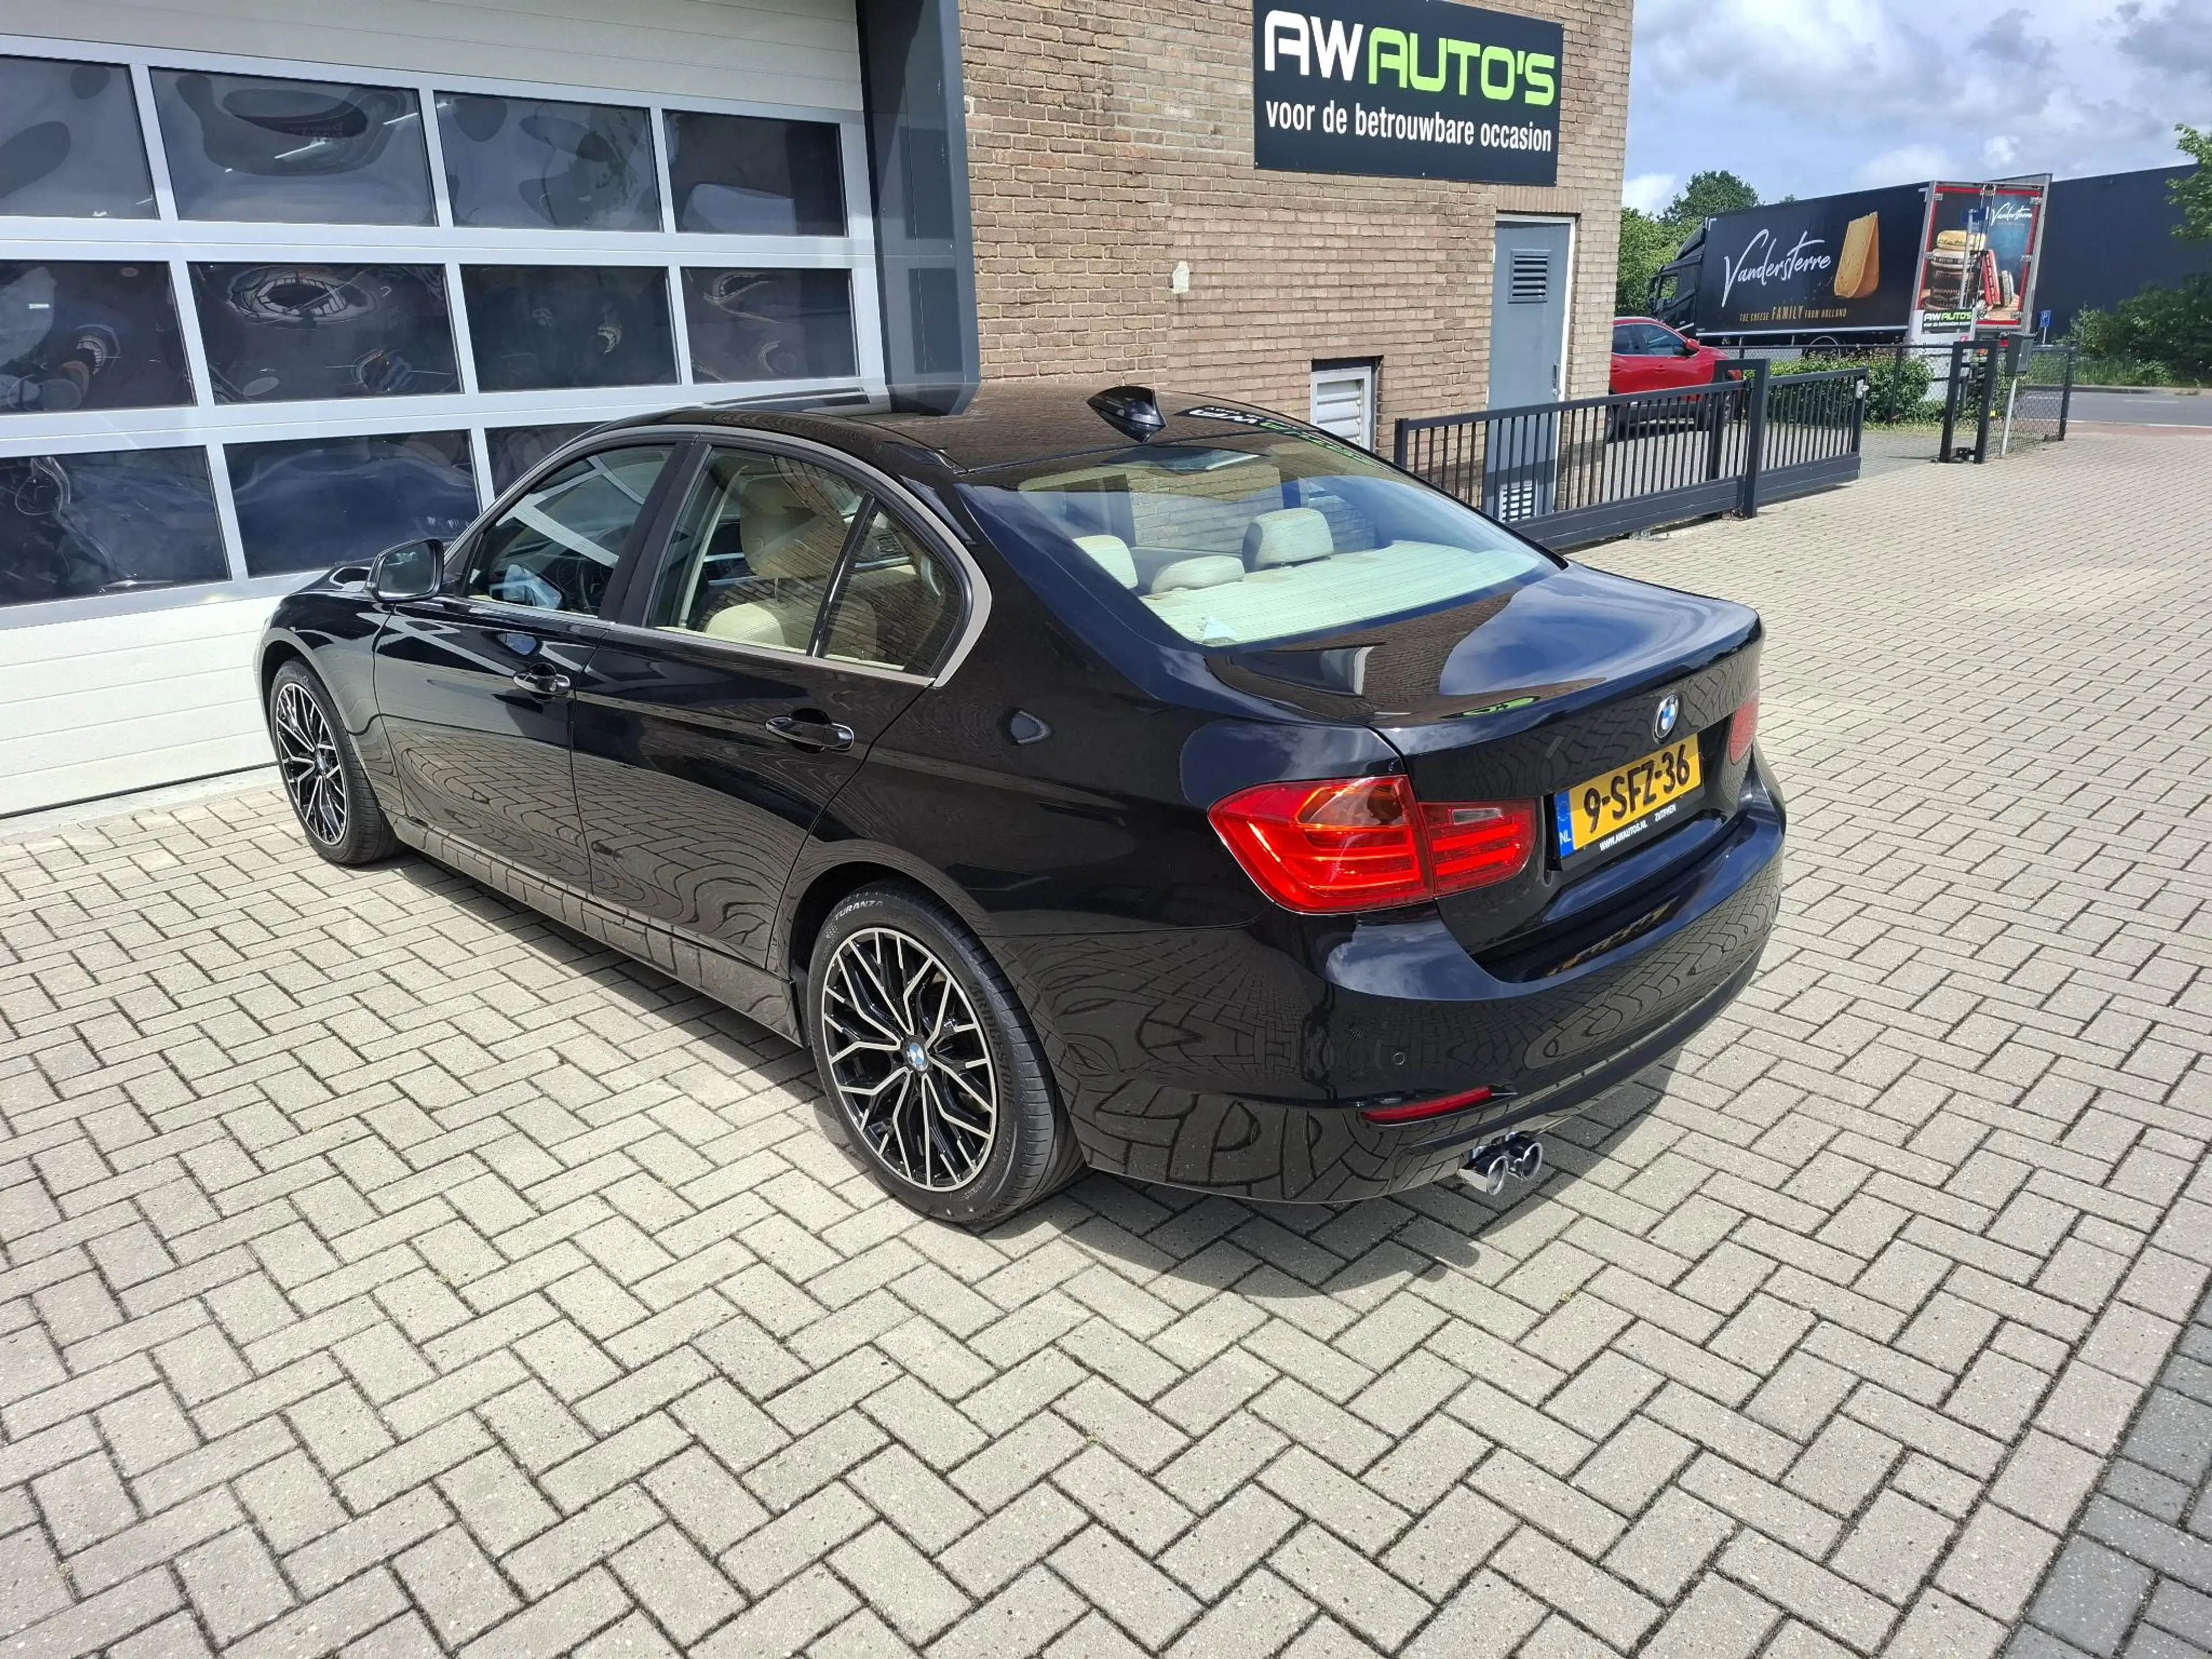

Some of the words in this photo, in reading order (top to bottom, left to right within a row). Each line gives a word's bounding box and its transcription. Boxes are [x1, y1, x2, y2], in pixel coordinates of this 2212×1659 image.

[1266, 100, 1315, 131] voor
[1323, 100, 1348, 134] de
[1355, 103, 1474, 146] betrouwbare
[1480, 121, 1552, 152] occasion
[1721, 229, 1832, 308] Vandersterre
[1771, 304, 1804, 320] FAMILY
[1821, 308, 1847, 319] HOLLAND
[1584, 744, 1690, 834] 9-SFZ-36
[1559, 830, 1572, 845] NL
[834, 900, 883, 921] TURANZA
